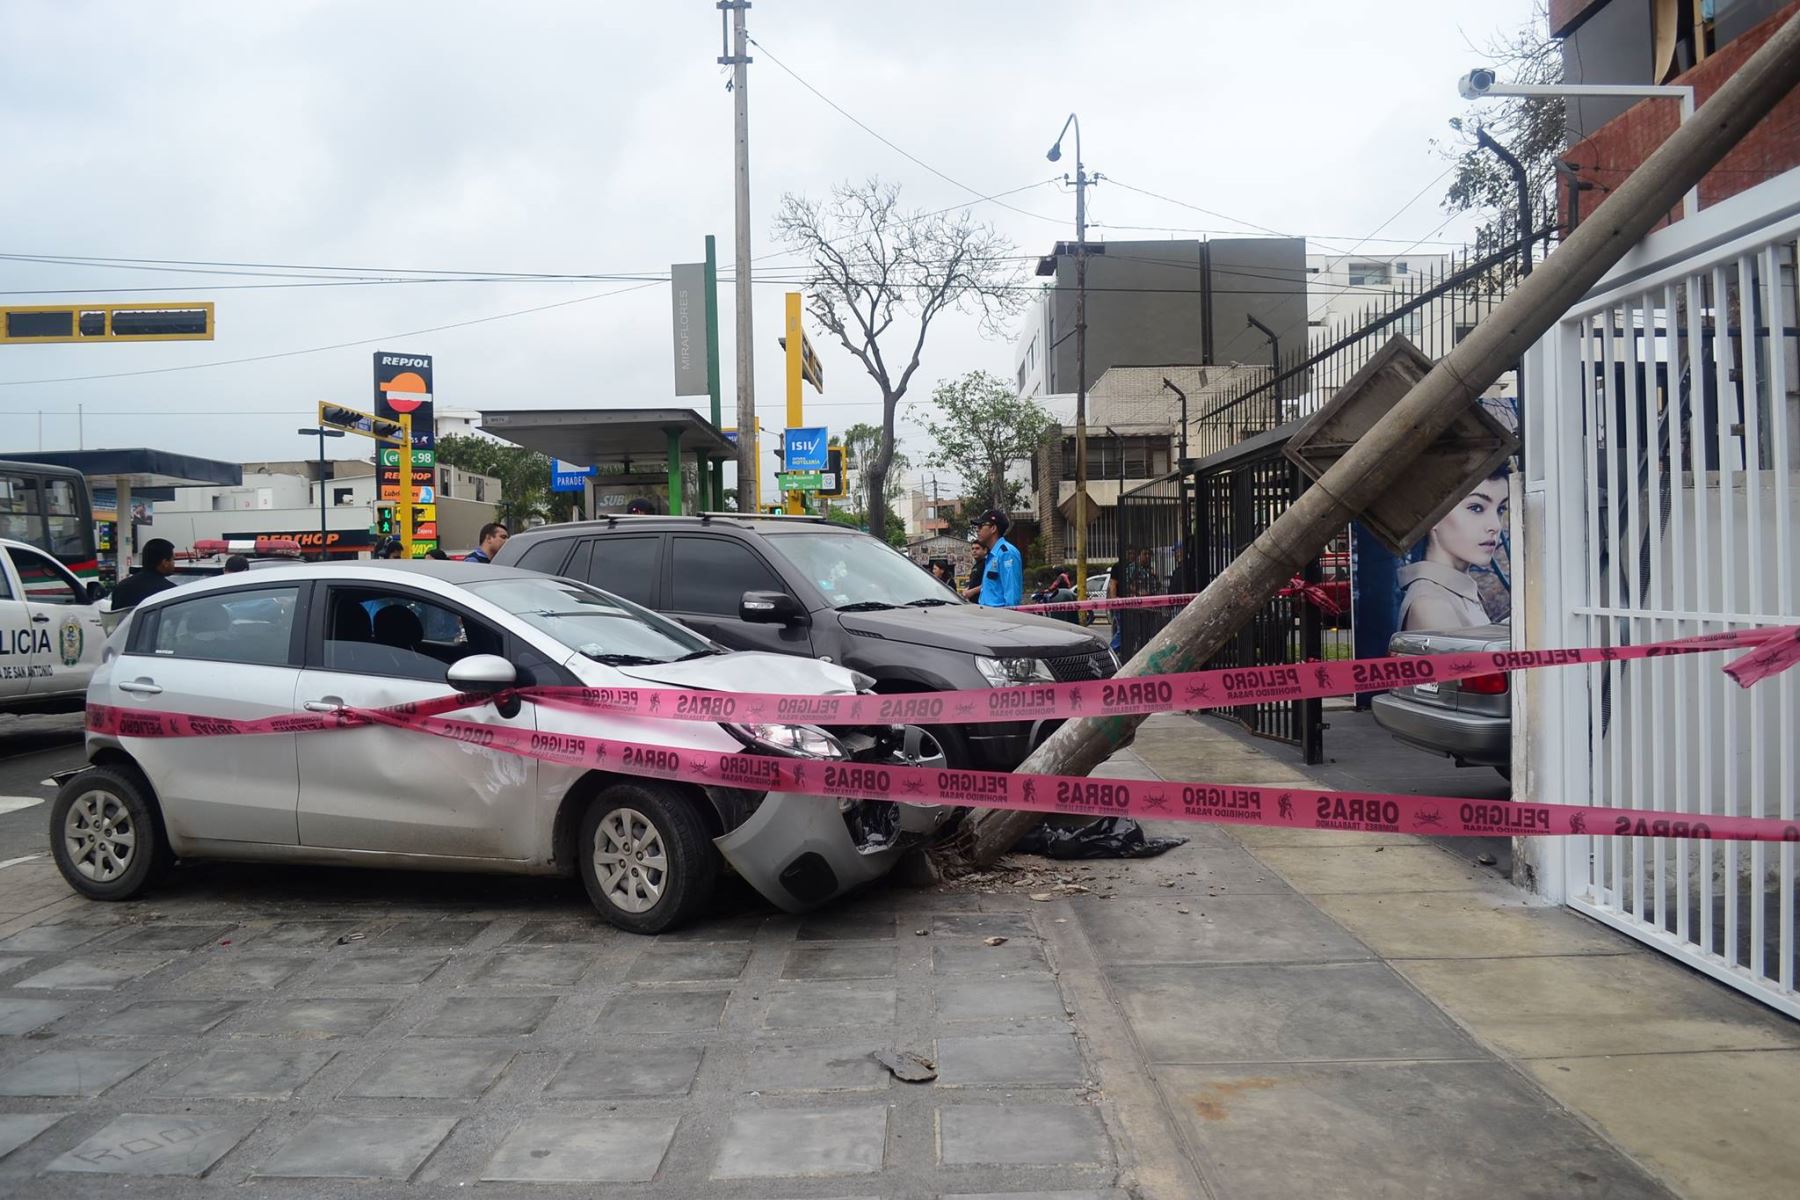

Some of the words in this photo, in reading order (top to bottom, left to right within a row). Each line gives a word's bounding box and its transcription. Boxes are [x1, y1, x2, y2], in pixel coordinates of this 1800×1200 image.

[680, 290, 689, 370] MIRAFLORES
[382, 356, 430, 368] REPSOL
[418, 454, 432, 464] 98
[0, 628, 52, 655] LICIA
[3, 667, 13, 679] DE
[13, 666, 26, 679] SAN
[27, 665, 54, 677] ANTONIO
[119, 719, 164, 735] PELIGRO
[190, 720, 242, 735] OBRAS
